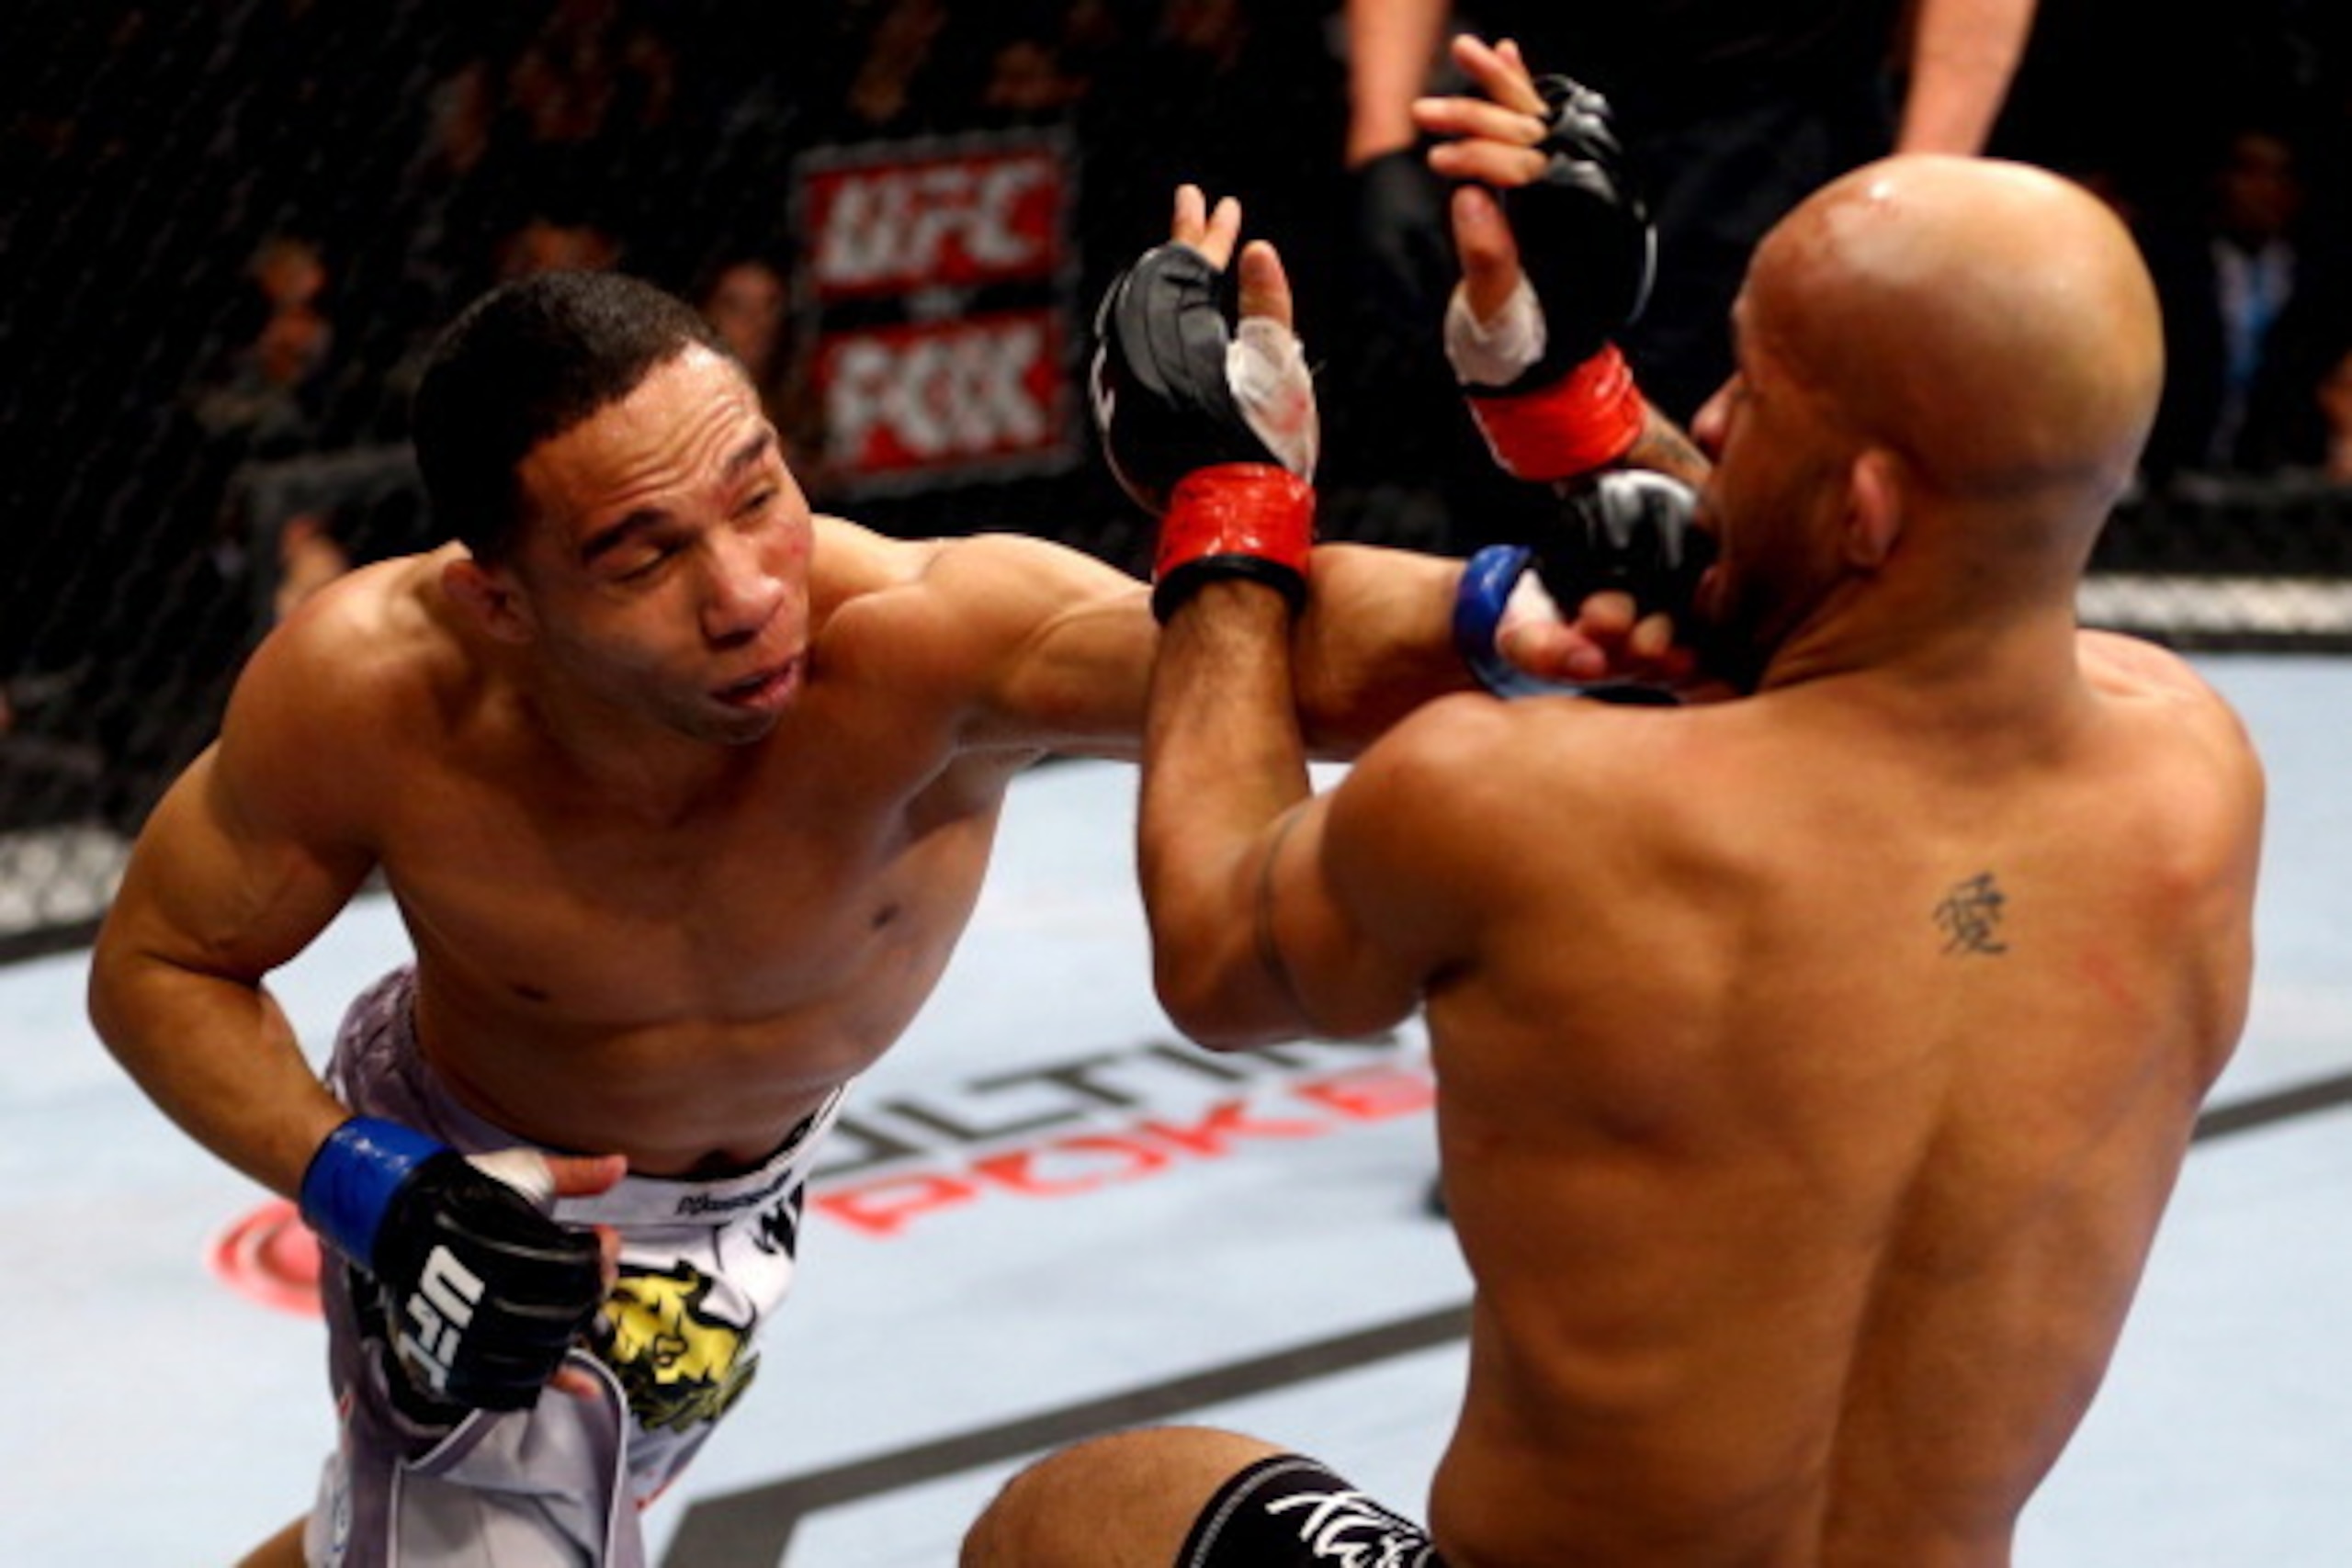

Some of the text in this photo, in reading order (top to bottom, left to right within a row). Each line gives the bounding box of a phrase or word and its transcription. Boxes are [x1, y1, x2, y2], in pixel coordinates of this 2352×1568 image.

[823, 159, 1044, 283] UFC
[831, 319, 1047, 461] FOX
[1931, 872, 2007, 956] 愛
[395, 1244, 486, 1395] UFC
